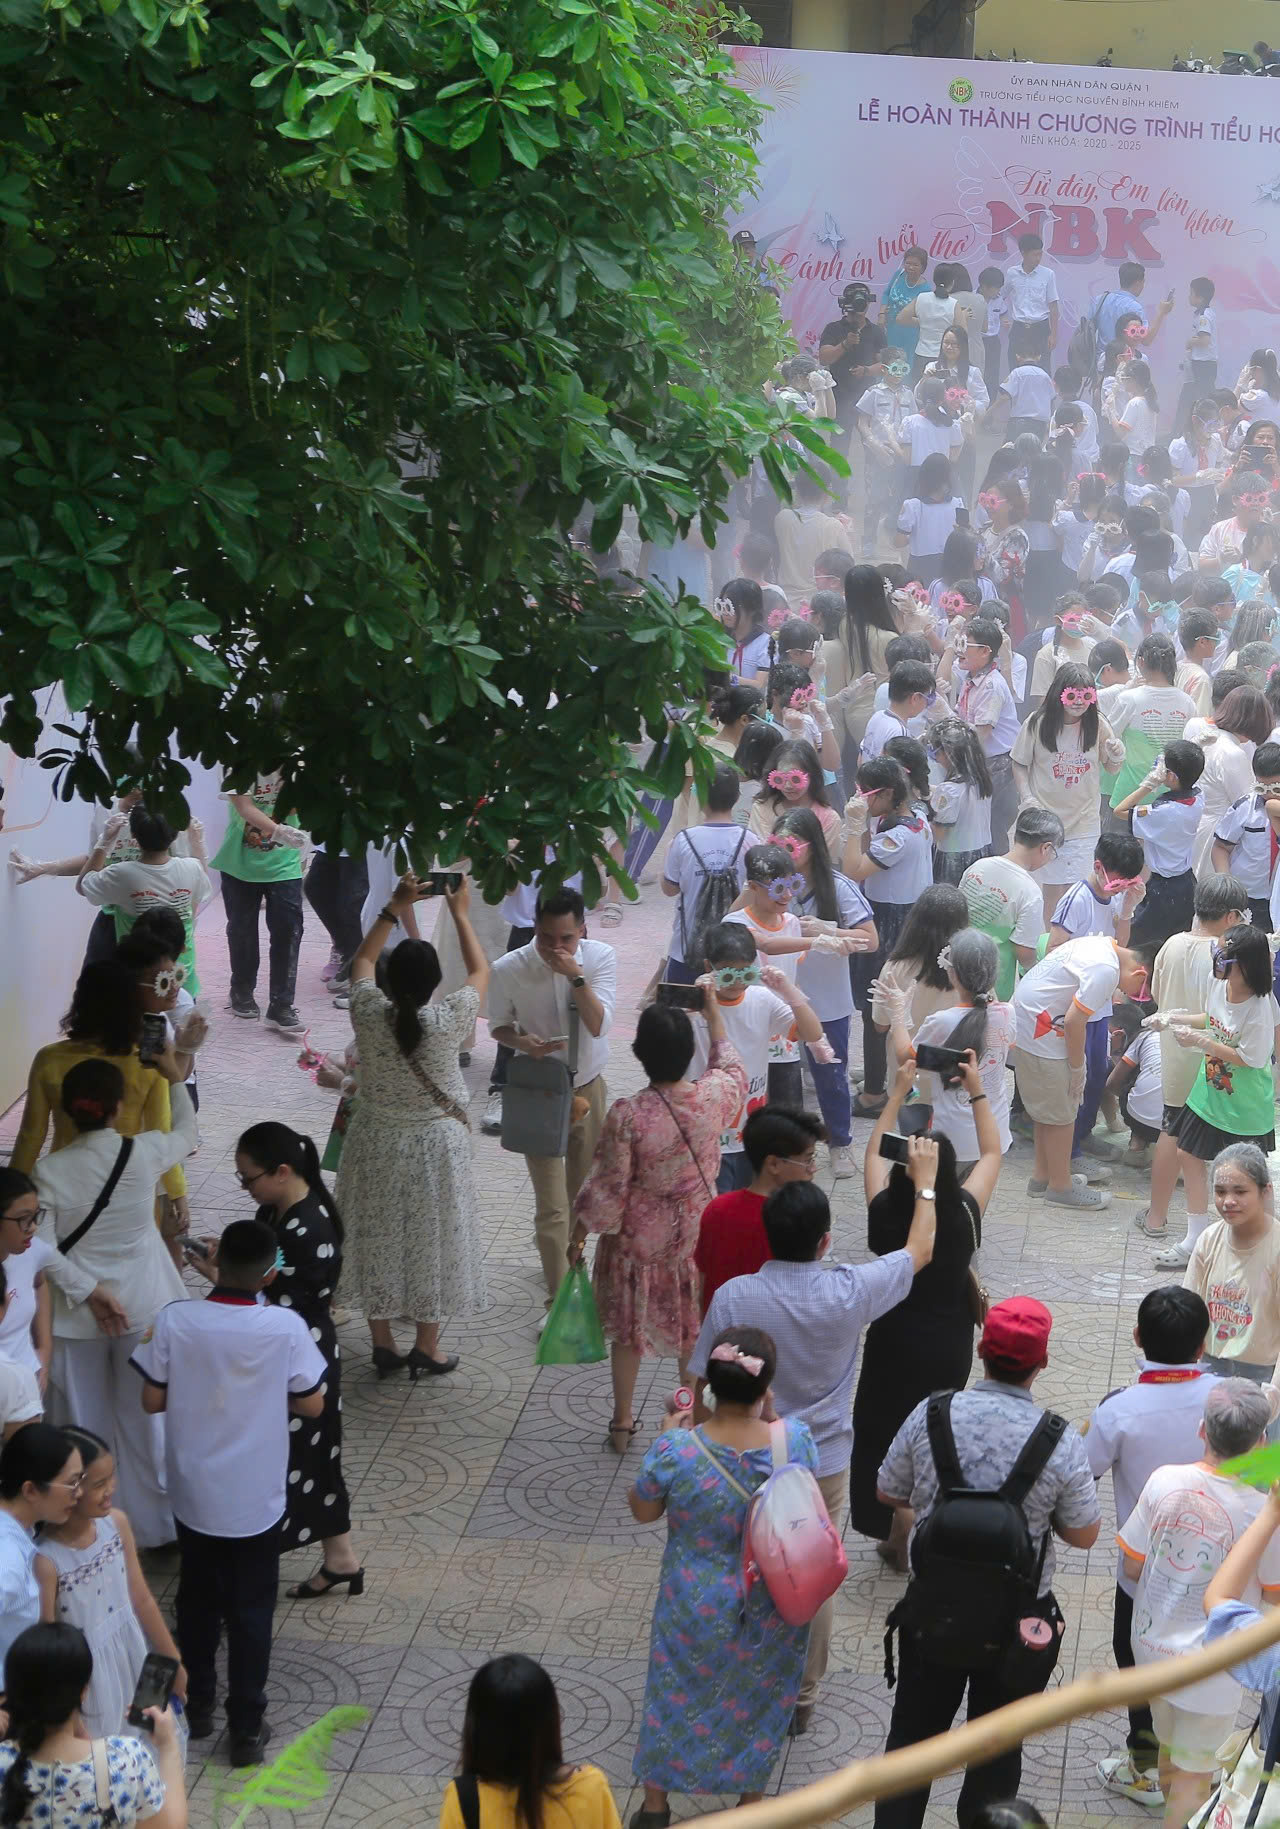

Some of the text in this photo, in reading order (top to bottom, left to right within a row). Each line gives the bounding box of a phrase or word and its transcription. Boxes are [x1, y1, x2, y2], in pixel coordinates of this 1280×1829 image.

[1025, 90, 1046, 102] TIỂU
[1048, 94, 1073, 104] HỌC
[1148, 99, 1179, 110] KHIÊM
[1027, 78, 1048, 87] BAN
[1051, 78, 1081, 88] NHÂN
[1084, 80, 1107, 90] DÂN
[1110, 82, 1142, 93] QUẬN
[858, 97, 880, 122] LỄ
[887, 103, 952, 126] HOÀN
[959, 106, 1030, 130] THÀNH
[1038, 112, 1137, 136] CHƯƠNG
[1144, 116, 1203, 140] TRÌNH
[1210, 115, 1251, 142] TIỂU
[1020, 133, 1045, 146] NIÊN
[1047, 134, 1081, 147] KHÓA:
[1084, 138, 1107, 149] 2020
[1118, 139, 1142, 151] 2025
[996, 165, 1052, 198] Từ
[1098, 171, 1151, 202] Em
[1157, 187, 1190, 217] lớn
[1185, 208, 1248, 241] khôn
[761, 222, 975, 282] Cánh én tuổi thơ
[986, 200, 1162, 262] NBK
